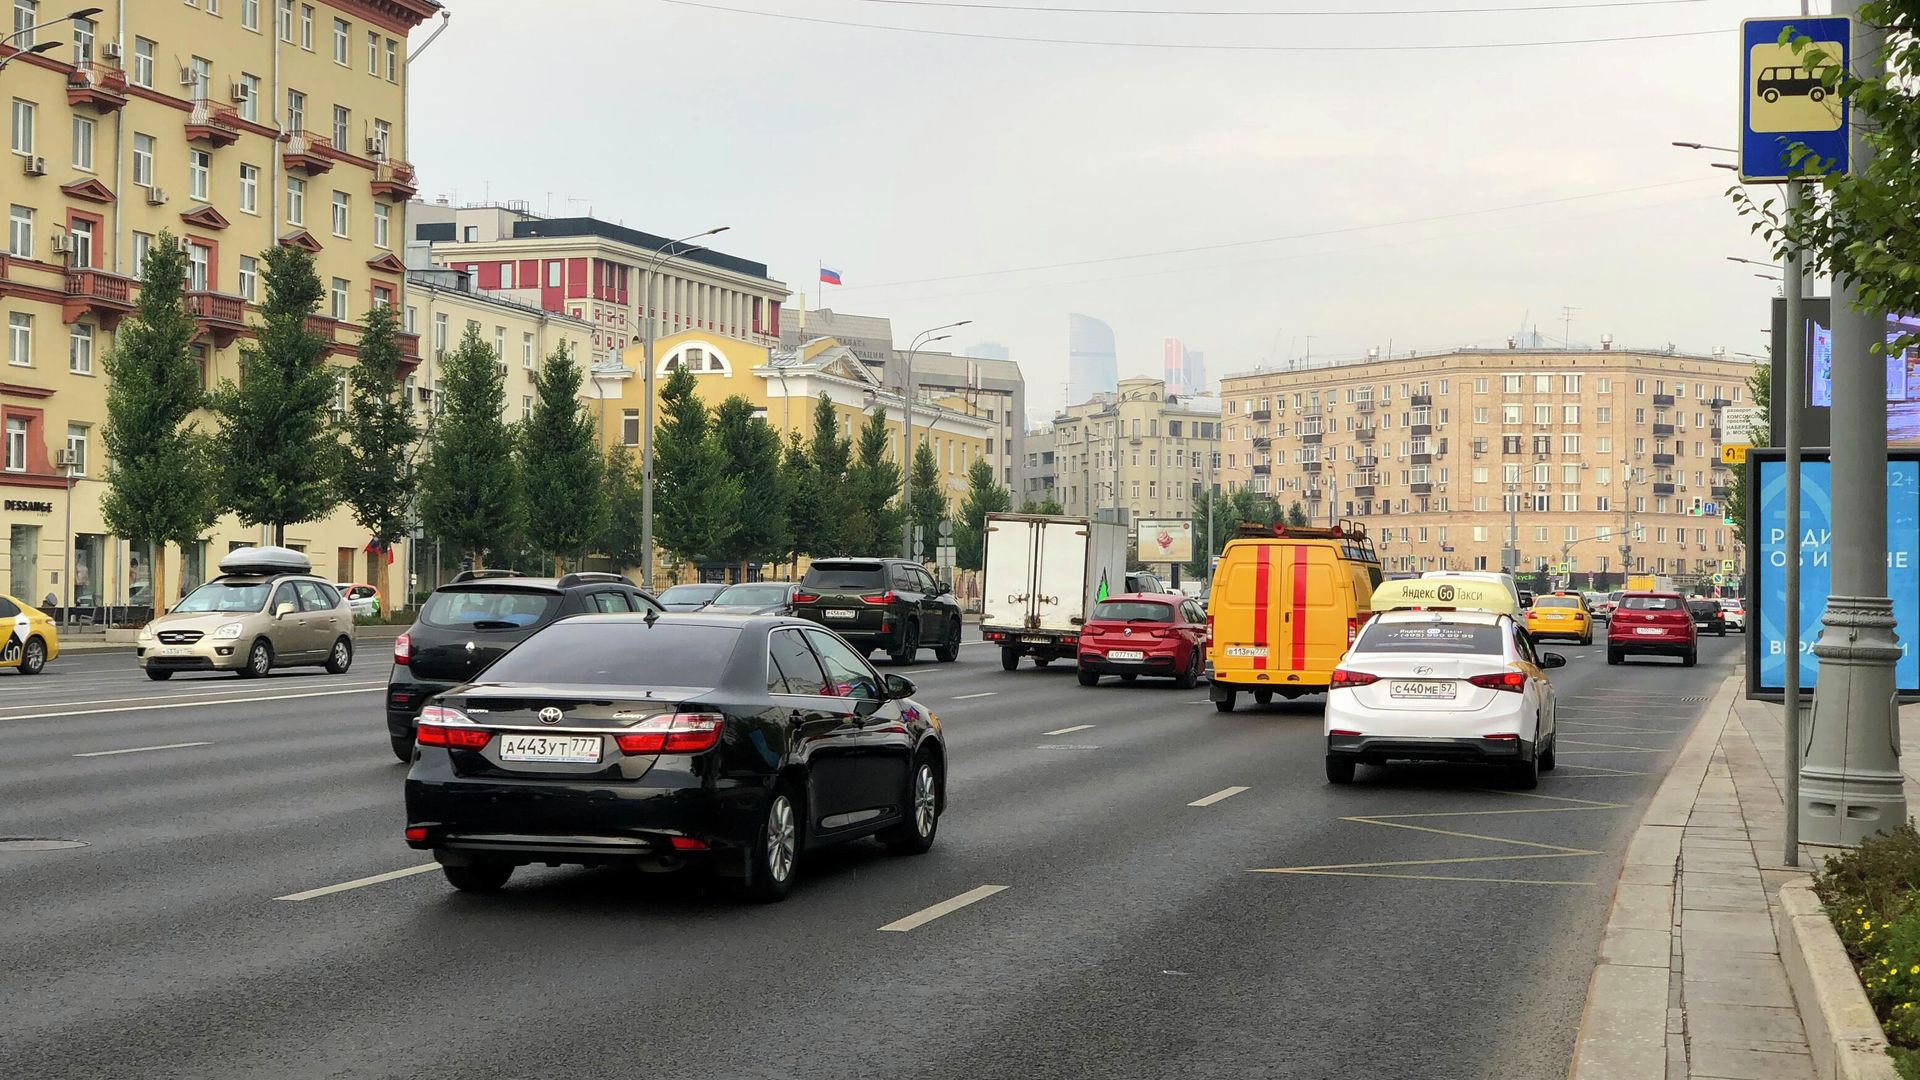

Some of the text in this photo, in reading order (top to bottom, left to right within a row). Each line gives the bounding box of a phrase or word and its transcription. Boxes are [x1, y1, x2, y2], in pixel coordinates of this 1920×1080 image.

[4, 499, 53, 513] DESSANGE
[1771, 528, 1832, 548] РДИ
[1402, 585, 1483, 601] Яндекс Go Такси
[1441, 683, 1452, 692] 57
[506, 738, 596, 756] А443УТ 777
